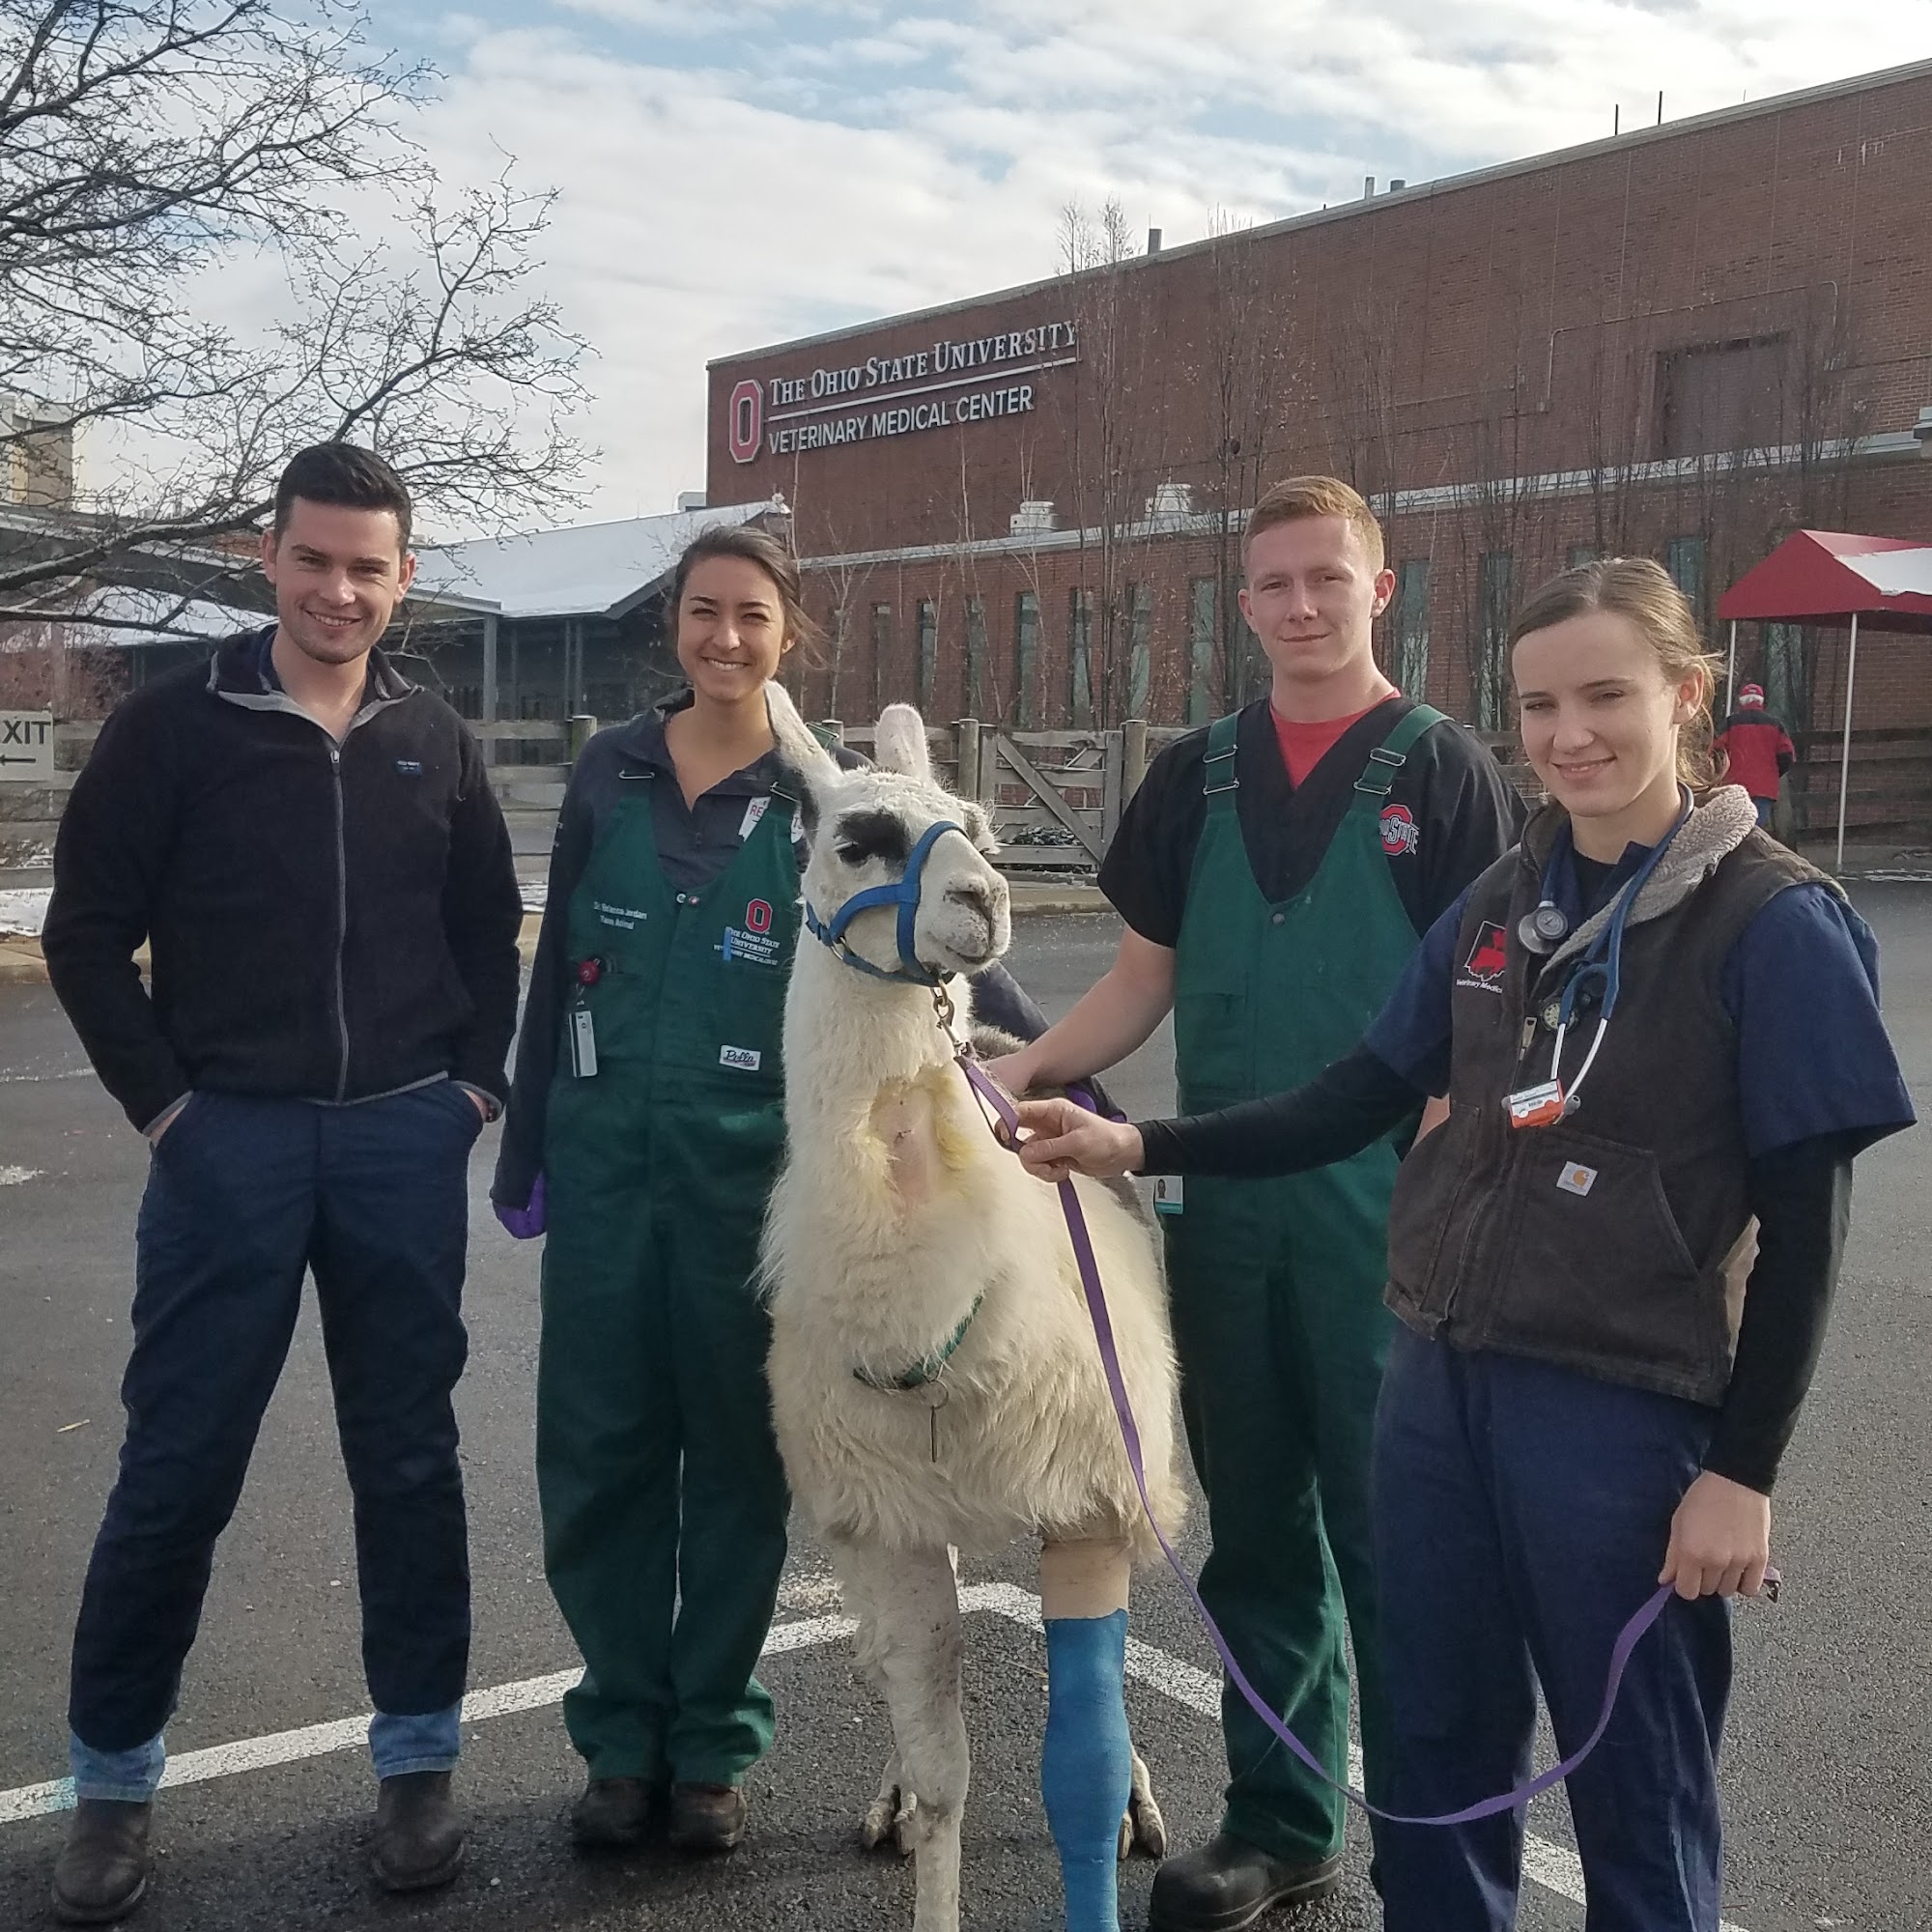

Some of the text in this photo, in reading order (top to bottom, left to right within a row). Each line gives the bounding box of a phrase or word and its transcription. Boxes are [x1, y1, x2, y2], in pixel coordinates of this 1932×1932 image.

[770, 320, 1077, 406] THE OHIO STATE UNIVERSITY
[769, 385, 1035, 455] VETERINARY MEDICAL CENTER
[2, 720, 51, 744] XIT
